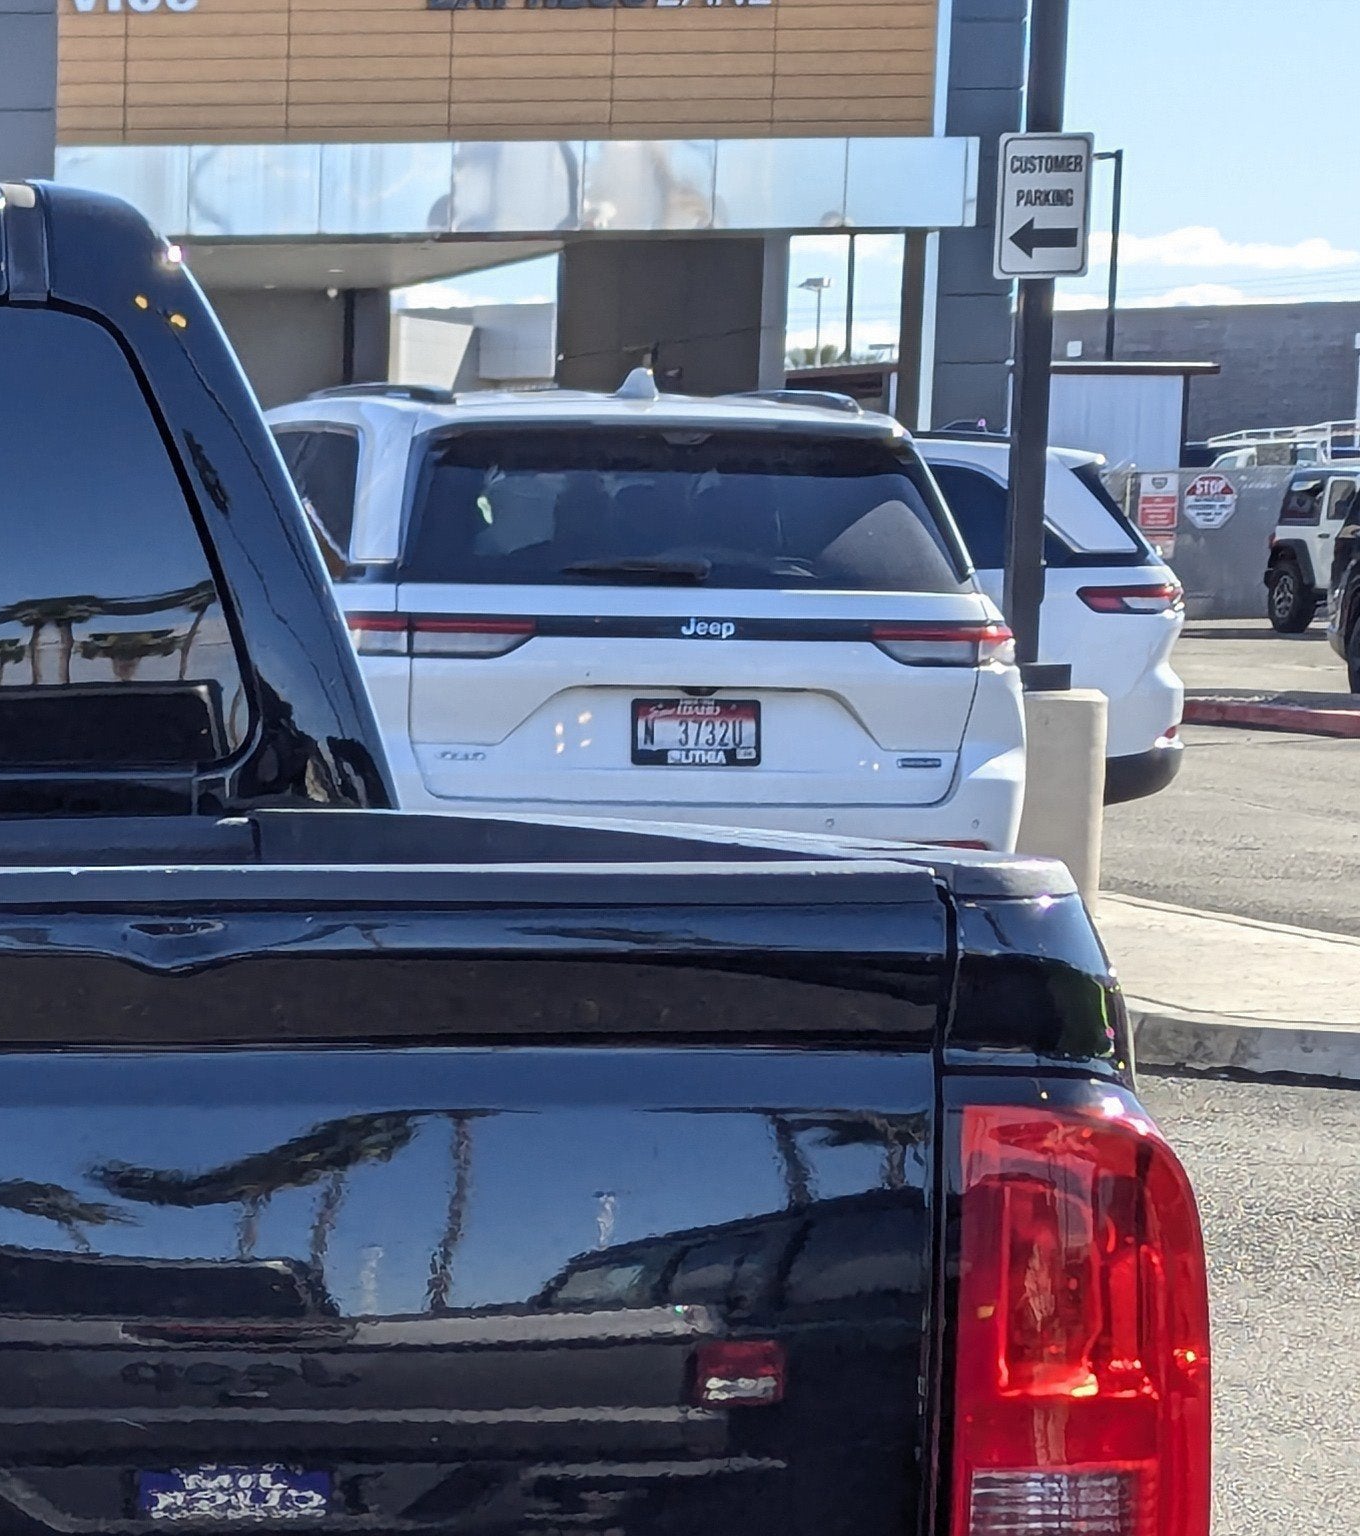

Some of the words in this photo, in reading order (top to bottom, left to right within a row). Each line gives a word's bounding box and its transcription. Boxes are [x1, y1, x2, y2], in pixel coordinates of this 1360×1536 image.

[1010, 155, 1083, 174] CUSTOMER
[1016, 188, 1074, 207] PARKING
[1195, 480, 1225, 495] STOP
[681, 617, 735, 639] Jeep
